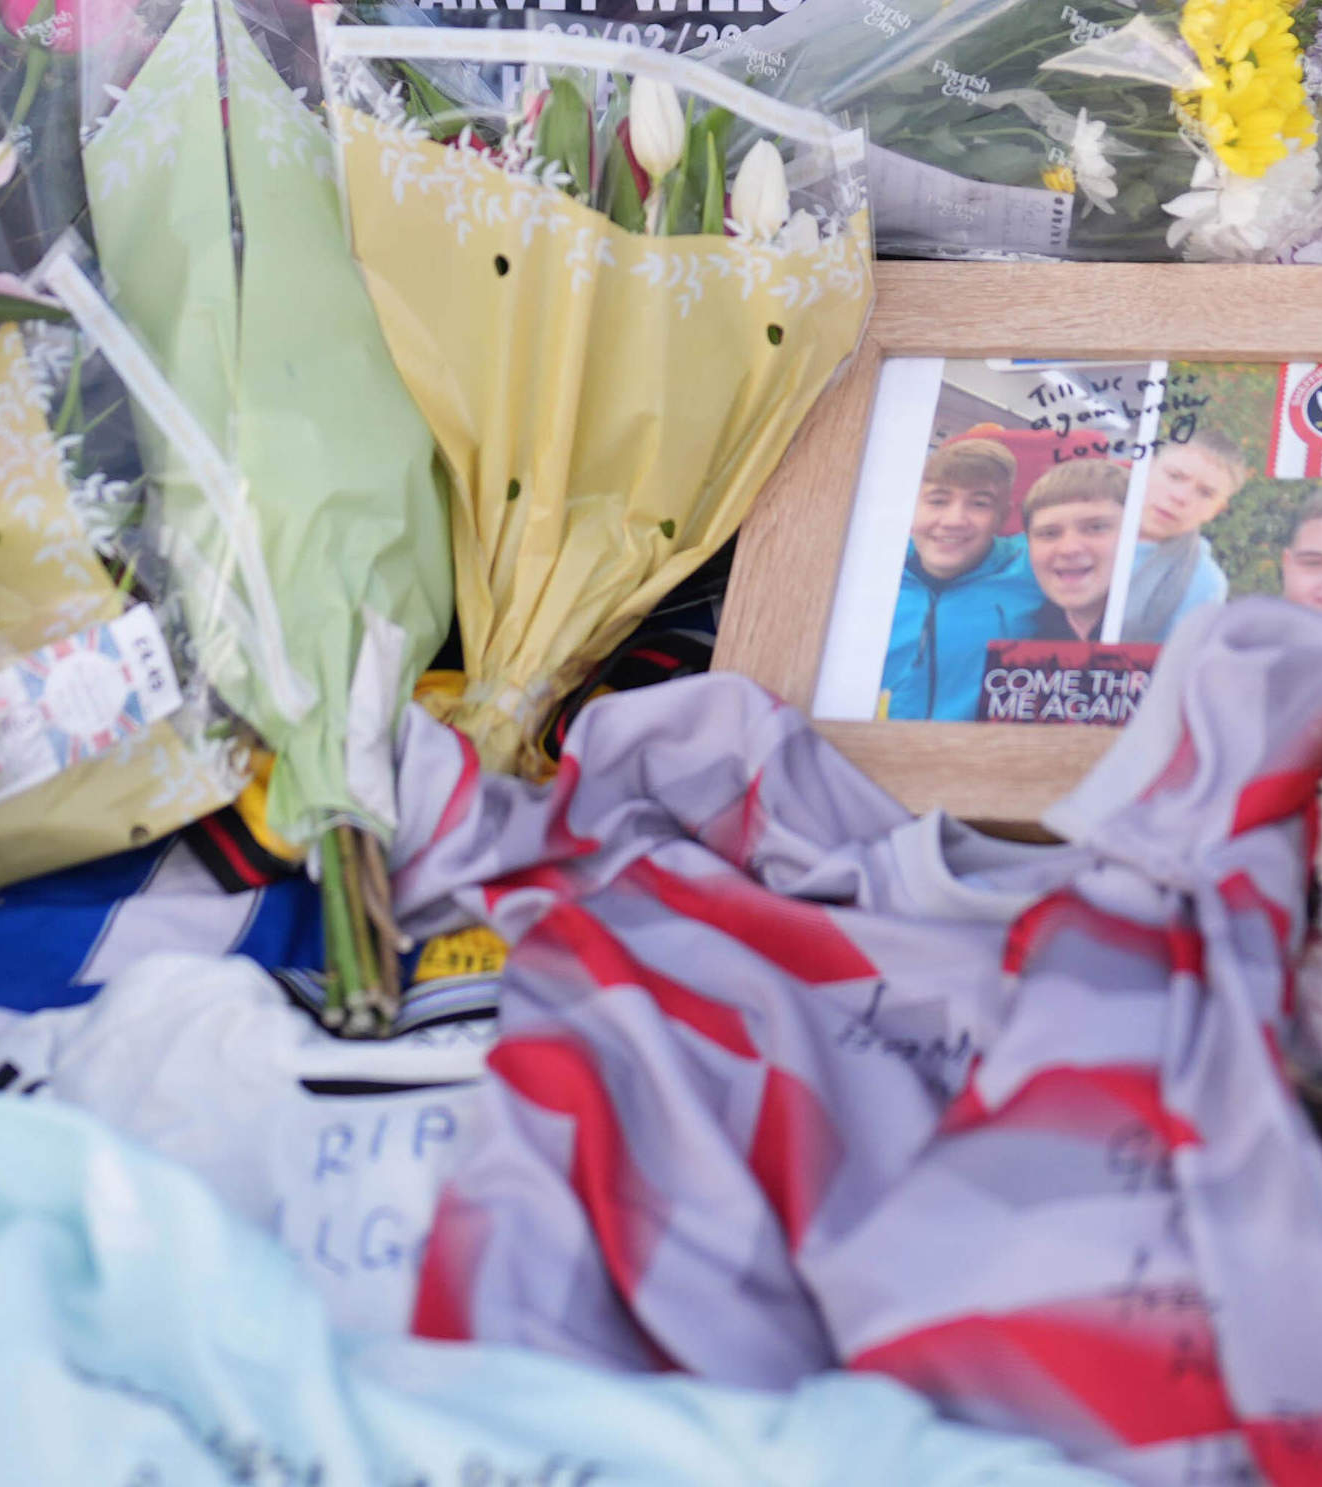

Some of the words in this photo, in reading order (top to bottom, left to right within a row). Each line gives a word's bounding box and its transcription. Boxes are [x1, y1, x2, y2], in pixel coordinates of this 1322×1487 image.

[932, 59, 991, 95] Flourish
[1028, 382, 1074, 408] Till
[983, 667, 1083, 696] COME
[1086, 668, 1151, 697] THR
[986, 692, 1037, 721] ME
